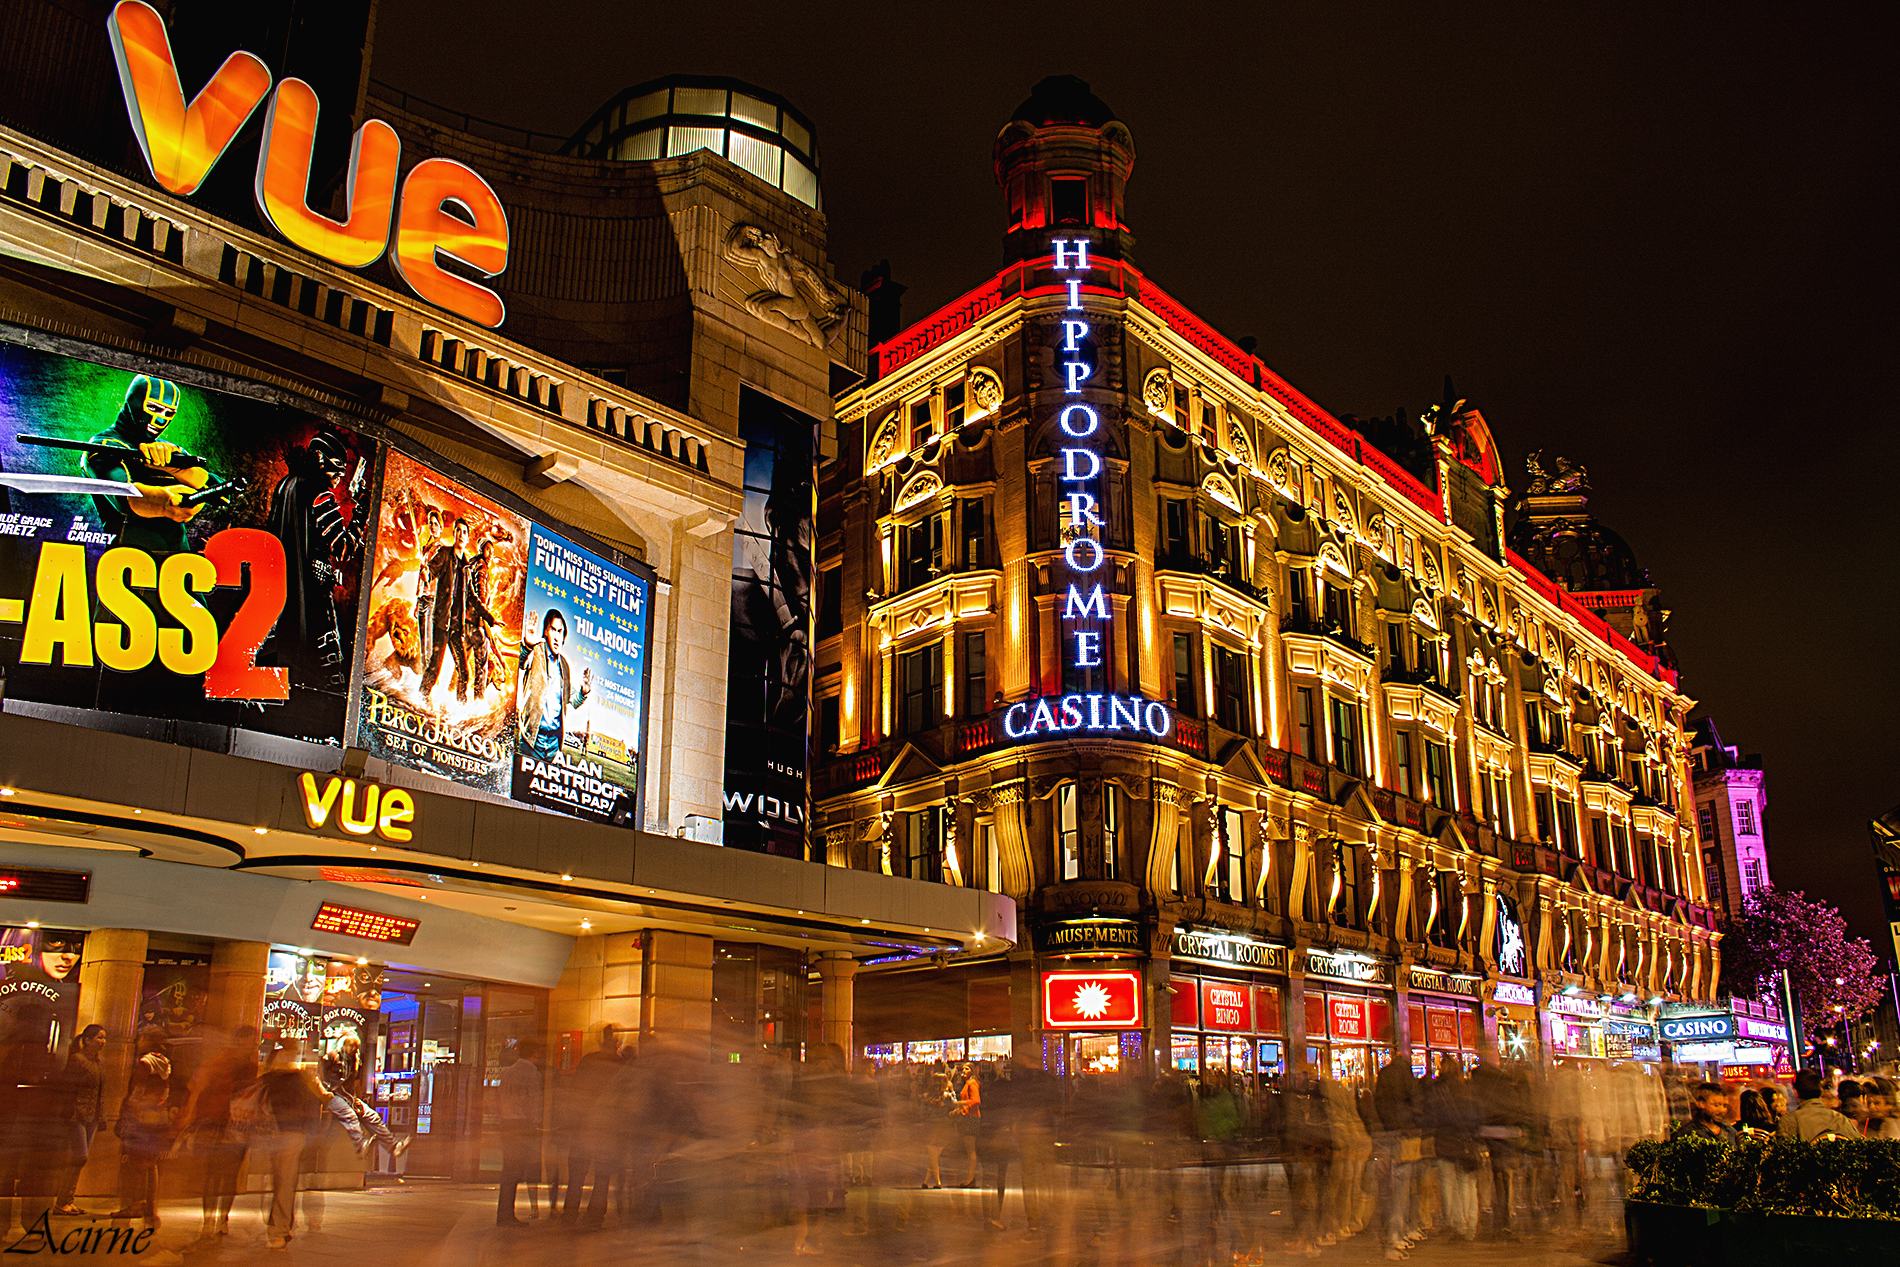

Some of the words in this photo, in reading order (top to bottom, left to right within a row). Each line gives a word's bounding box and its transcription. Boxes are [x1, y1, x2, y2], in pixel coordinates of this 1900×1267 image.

[1051, 238, 1111, 667] HIPPODROME
[20, 516, 53, 528] GRACE
[71, 522, 90, 531] JIM
[67, 530, 117, 545] CARREY
[535, 547, 607, 598] FUNNIEST
[563, 548, 583, 567] MISS
[584, 559, 602, 577] THIS
[602, 570, 642, 597] SUMMER'S
[204, 527, 289, 700] 2
[366, 685, 428, 737] PERCY
[425, 713, 507, 763] JACKSON
[1004, 695, 1170, 738] CASINO
[385, 734, 408, 752] SEA
[412, 742, 428, 757] OF
[432, 749, 489, 776] MONSTERS
[552, 750, 603, 779] ALAN
[767, 760, 803, 779] HUGH
[529, 777, 579, 802] ALPHA
[1047, 927, 1138, 945] AMUSEMENTS
[1178, 935, 1233, 961] CRYSTAL
[1236, 943, 1275, 966] ROOMS
[1310, 955, 1352, 978] CRYSTAL
[0, 982, 18, 997] OX
[20, 981, 60, 1002] OFFICE
[1412, 971, 1445, 991] CRYSTAL
[1447, 977, 1472, 995] ROOMS
[1210, 989, 1243, 1007] CRYSTAL
[263, 1000, 280, 1015] BOX
[281, 999, 308, 1019] OFFICE
[323, 1008, 340, 1022] BOX
[341, 1007, 366, 1025] OFFICE
[1216, 1008, 1240, 1025] BINGO
[1335, 1002, 1360, 1019] CRYSTAL
[1606, 1034, 1632, 1043] HALF
[1664, 1020, 1728, 1037] CASINO
[1607, 1043, 1632, 1051] PRICE
